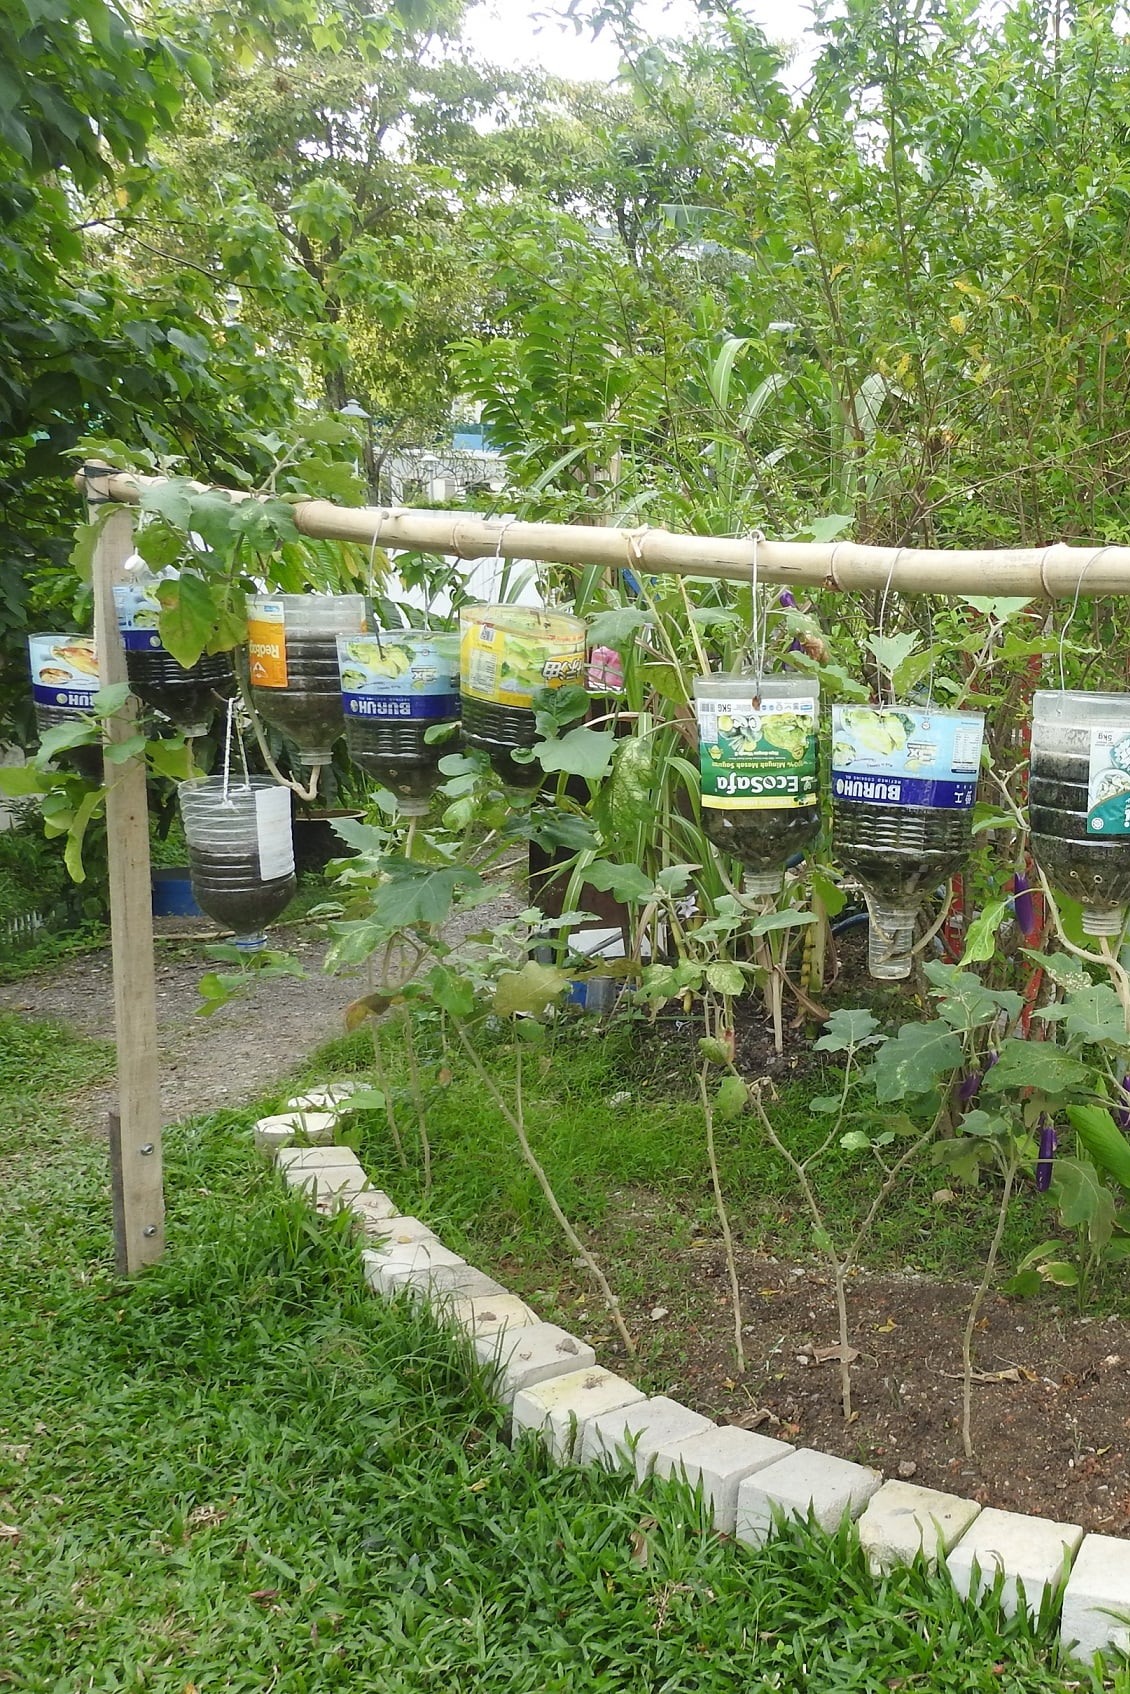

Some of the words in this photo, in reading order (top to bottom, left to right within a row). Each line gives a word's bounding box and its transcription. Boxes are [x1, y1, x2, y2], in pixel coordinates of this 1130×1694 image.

[358, 700, 411, 715] BURUH
[717, 704, 732, 712] 5KG
[1098, 732, 1112, 741] 5kg
[736, 762, 758, 770] Masak
[760, 761, 786, 769] Minyak
[716, 772, 798, 794] EcoSafa
[844, 780, 900, 800] BURUH
